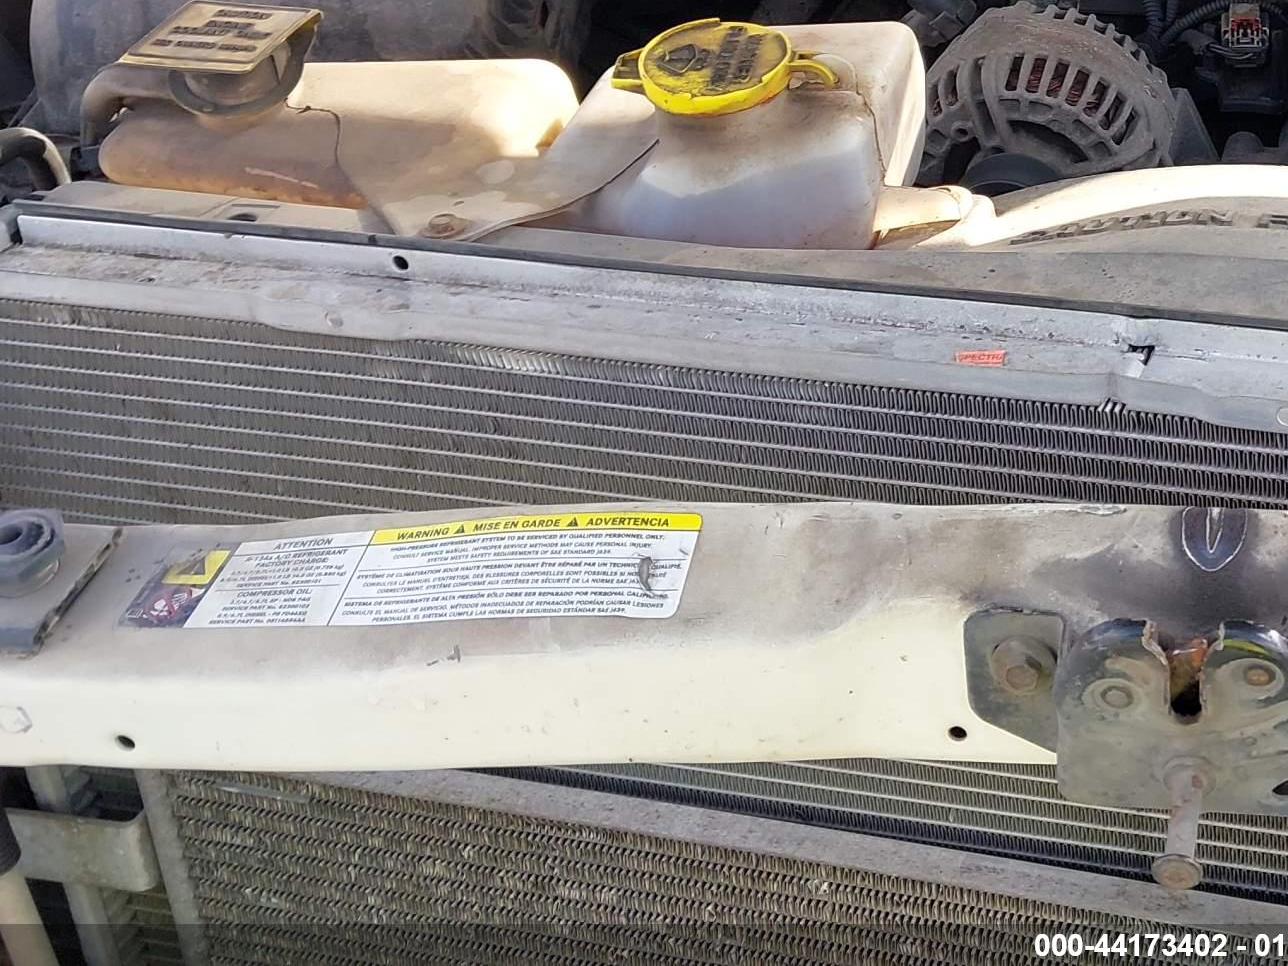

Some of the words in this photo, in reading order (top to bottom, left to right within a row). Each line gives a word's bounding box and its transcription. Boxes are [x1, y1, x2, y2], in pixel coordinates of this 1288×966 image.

[397, 527, 449, 540] WARNING
[474, 522, 502, 531] MISE
[504, 521, 519, 529] EN
[522, 519, 560, 528] GARDE
[586, 518, 670, 526] ADVERTENCIA
[274, 538, 333, 550] ATTENTION
[440, 538, 479, 547] REFRIGERANT
[472, 544, 501, 552] IMPROPER
[292, 549, 347, 559] REFRIGERANT
[256, 560, 292, 568] FACTORY
[238, 589, 294, 597] COMPRESSOR
